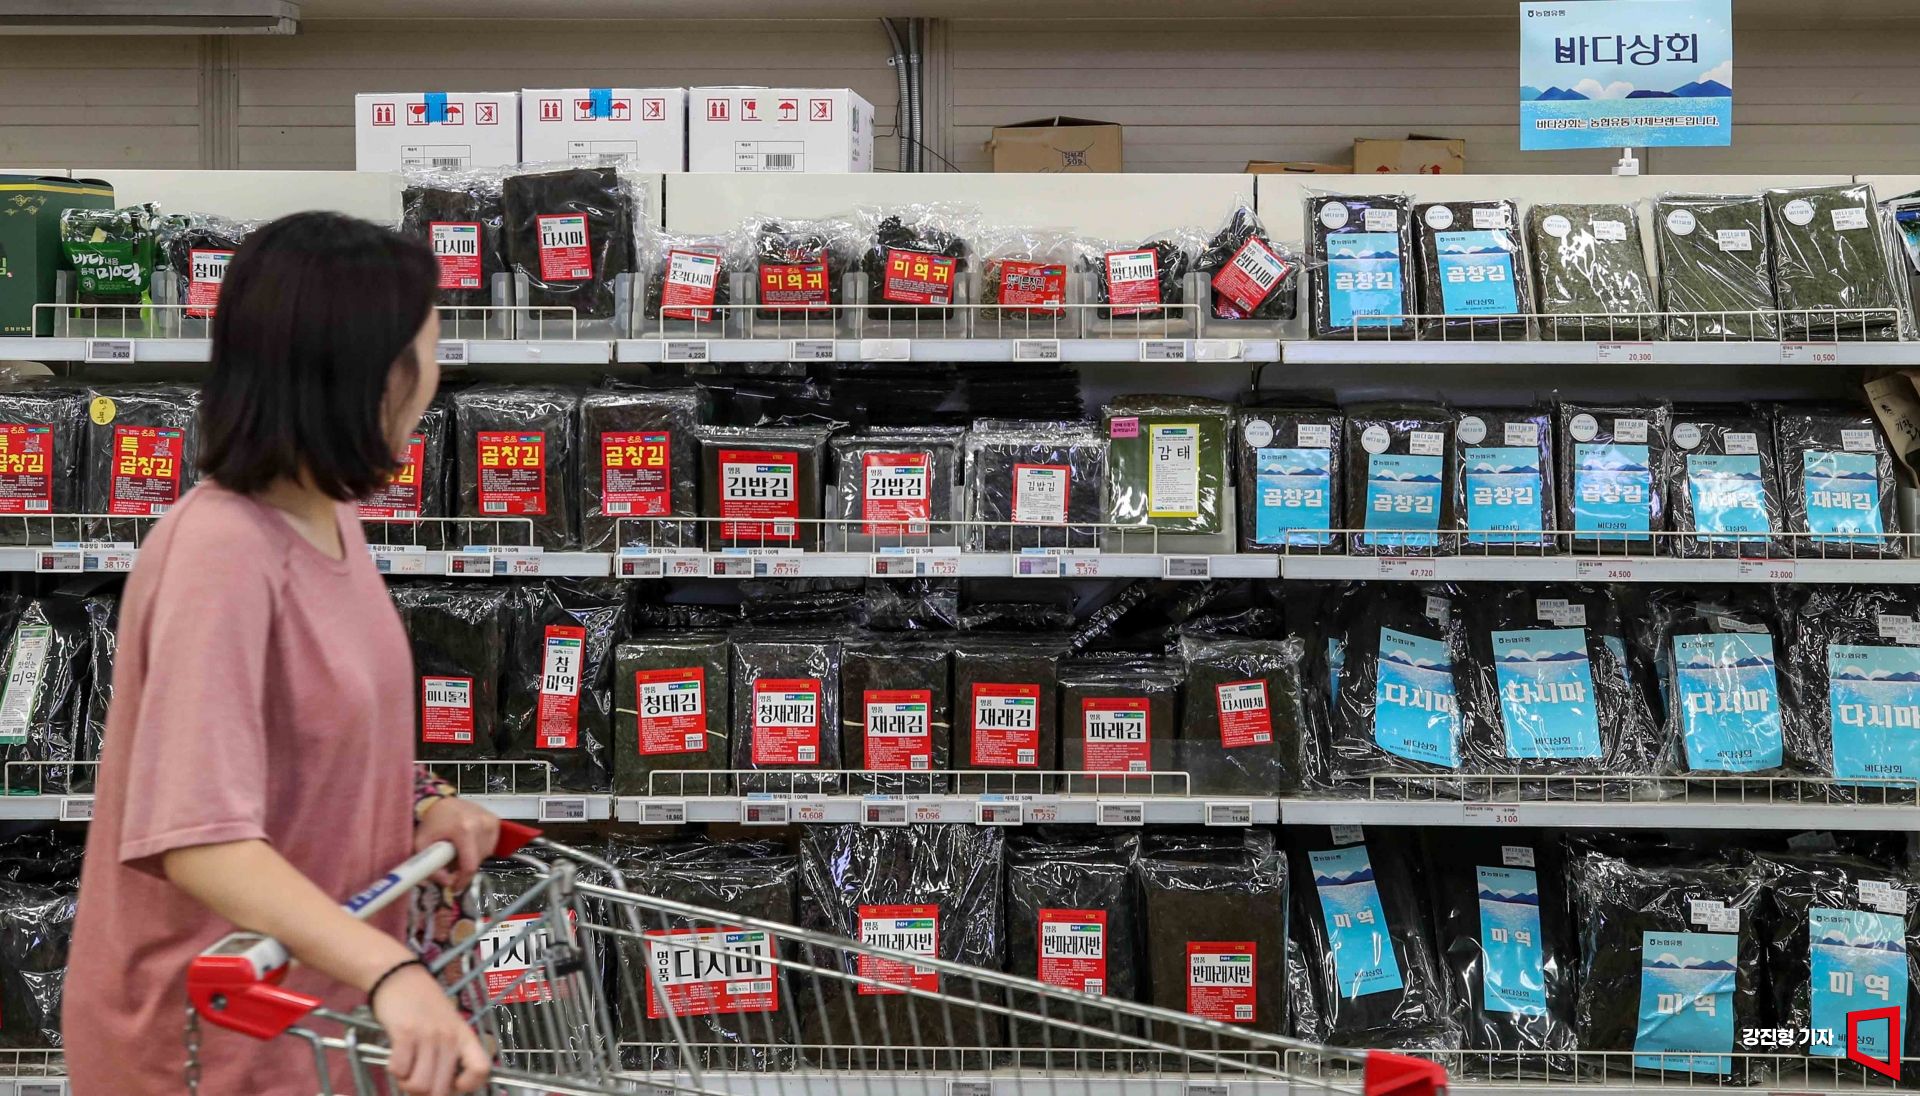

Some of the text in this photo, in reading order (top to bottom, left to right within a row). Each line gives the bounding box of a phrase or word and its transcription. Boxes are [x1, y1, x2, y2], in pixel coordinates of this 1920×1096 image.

[1555, 32, 1698, 66] 바다상회
[1536, 116, 1719, 129] 바다상회는 농협유통 자체브랜드입니다.
[434, 240, 476, 254] 다시마
[542, 232, 584, 247] 다시마
[670, 270, 712, 286] 조각다시마
[894, 260, 948, 284] 미역귀
[1112, 264, 1152, 281] 쌈다시마
[1236, 252, 1274, 288] 쌈다시마
[1446, 264, 1506, 282] 곱창김
[767, 272, 823, 290] 미역귀
[1336, 271, 1394, 290] 곱창김
[1040, 352, 1058, 360] 4,220
[1166, 352, 1184, 360] 6,190
[1628, 354, 1652, 362] 20,300
[1812, 354, 1836, 362] 10,500
[121, 436, 139, 456] 특
[1158, 445, 1190, 460] 감태
[482, 446, 539, 466] 곱창김
[606, 446, 664, 466] 곱창김
[120, 455, 173, 477] 곱창김
[727, 476, 790, 498] 김밥김
[870, 478, 922, 498] 김밥김
[1028, 481, 1055, 492] 김밥김
[1474, 486, 1534, 505] 곱창김
[1582, 484, 1642, 503] 곱창김
[1263, 488, 1323, 508] 곱창김
[1373, 494, 1433, 512] 곱창김
[1812, 490, 1872, 510] 재래김
[1598, 522, 1628, 530] 바다상회
[673, 566, 698, 574] 17,976
[932, 566, 956, 574] 11,232
[1076, 567, 1098, 575] 3,376
[1410, 570, 1433, 578] 47,720
[1608, 570, 1632, 578] 24,500
[1770, 570, 1792, 578] 23,000
[1392, 637, 1416, 648] 농협유통
[556, 656, 570, 673] 참
[12, 671, 37, 686] 미역
[546, 674, 574, 692] 미역
[1384, 682, 1459, 713] 다시마
[1507, 681, 1586, 704] 다시마
[1690, 688, 1769, 715] 다시마
[644, 693, 696, 714] 청태김
[871, 706, 884, 714] 명품
[1222, 698, 1264, 710] 다시마채
[759, 704, 814, 724] 청재래김
[978, 708, 1031, 728] 재래김
[1838, 703, 1920, 729] 다시마
[871, 715, 922, 734] 재래김
[1090, 722, 1141, 740] 파래김
[1403, 738, 1438, 752] 바다상회
[1536, 736, 1571, 745] 바다상회
[1864, 764, 1902, 774] 바다상회
[798, 811, 823, 820] 14,608
[914, 812, 940, 820] 19,096
[1030, 812, 1056, 821] 11,232
[1496, 815, 1518, 824] 3,100
[864, 921, 879, 931] 명품
[1334, 910, 1375, 928] 미역
[1044, 925, 1057, 933] 명품
[1490, 928, 1531, 947] 미역
[1044, 935, 1101, 956] 반파래자반
[674, 944, 762, 979] 다시마
[1193, 966, 1251, 984] 반파래자반
[1828, 970, 1890, 1001] 미역
[1657, 992, 1716, 1018] 미역
